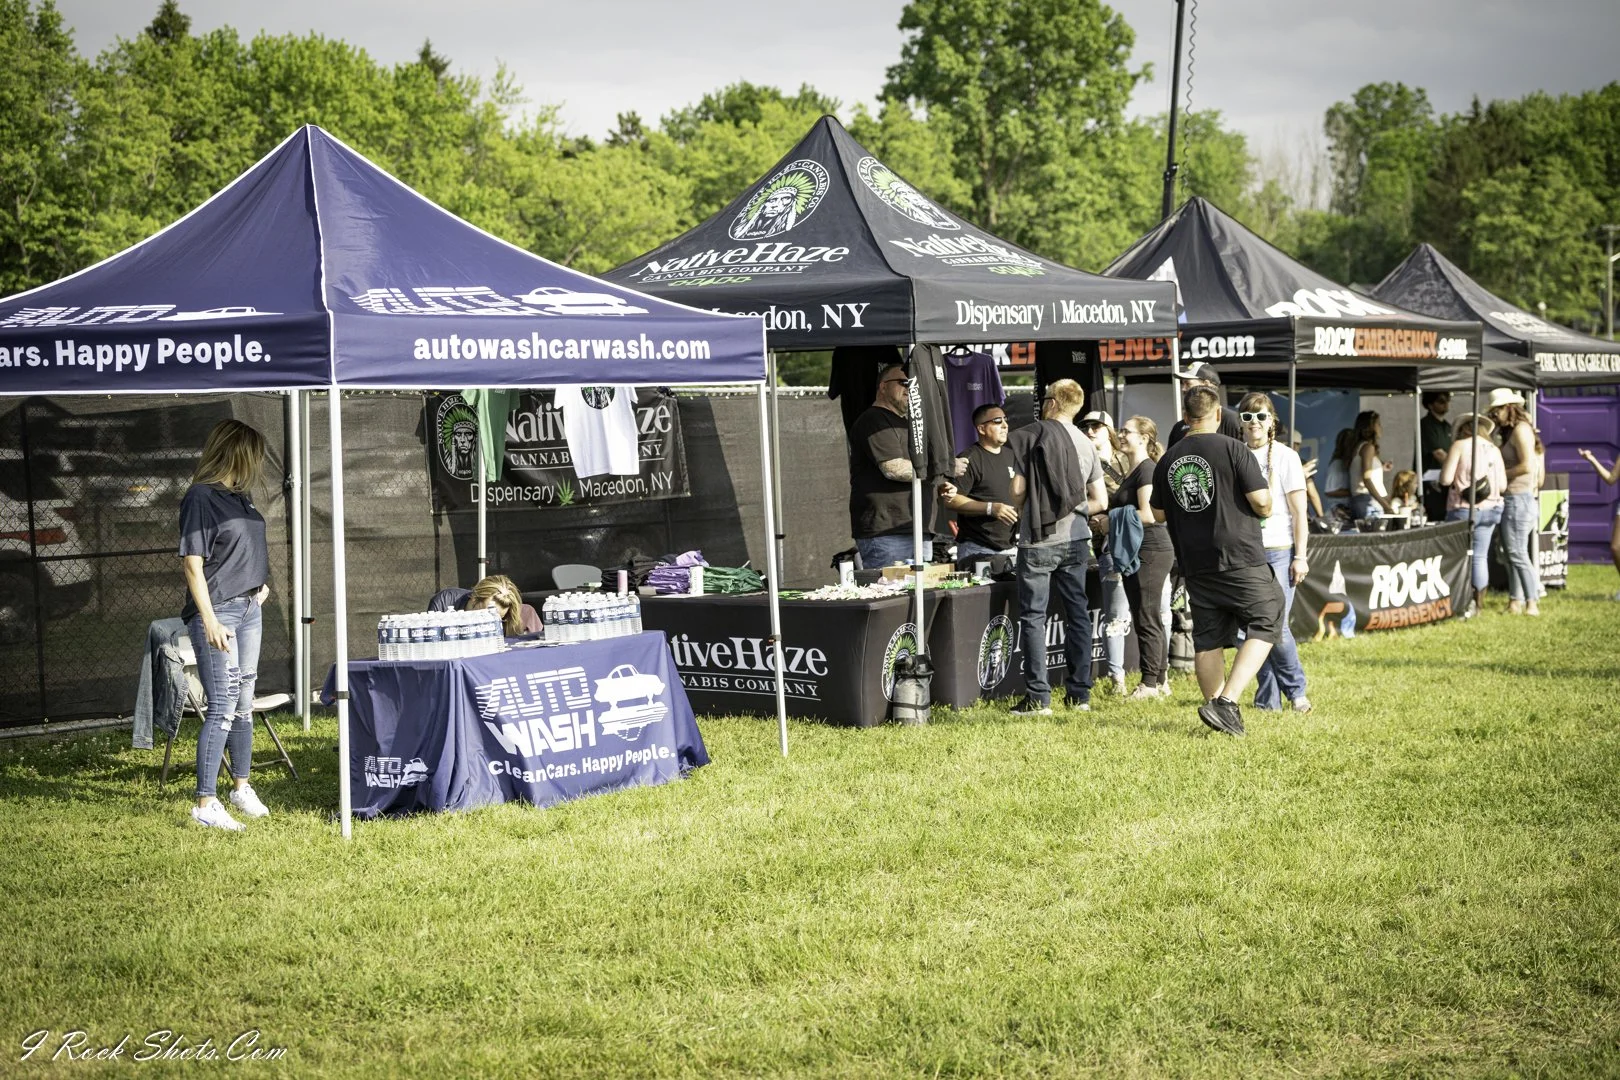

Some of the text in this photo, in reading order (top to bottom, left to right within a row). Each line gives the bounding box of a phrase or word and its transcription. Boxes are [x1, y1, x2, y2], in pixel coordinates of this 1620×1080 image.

[642, 264, 809, 282] CANNABIS COMPANY
[348, 286, 522, 313] AUTO
[0, 305, 177, 328] AUTO
[821, 302, 871, 329] NY
[955, 300, 1044, 332] Dispensary
[1060, 300, 1128, 326] Macedon,
[1130, 300, 1157, 323] NY
[0, 334, 271, 372] ars. Happy People.
[414, 332, 711, 360] autowashcarwash.com
[511, 451, 573, 466] CANNAB
[470, 470, 673, 504] Dspensary Macedon, NY
[1369, 555, 1450, 610] ROCK
[1364, 597, 1453, 630] EMERGENCY
[668, 633, 829, 676] tiveHaze
[475, 666, 592, 720] AUTO
[681, 676, 818, 697] NABIS COMANY
[484, 709, 597, 758] WASH
[582, 754, 624, 775] Happy
[625, 744, 676, 766] People.
